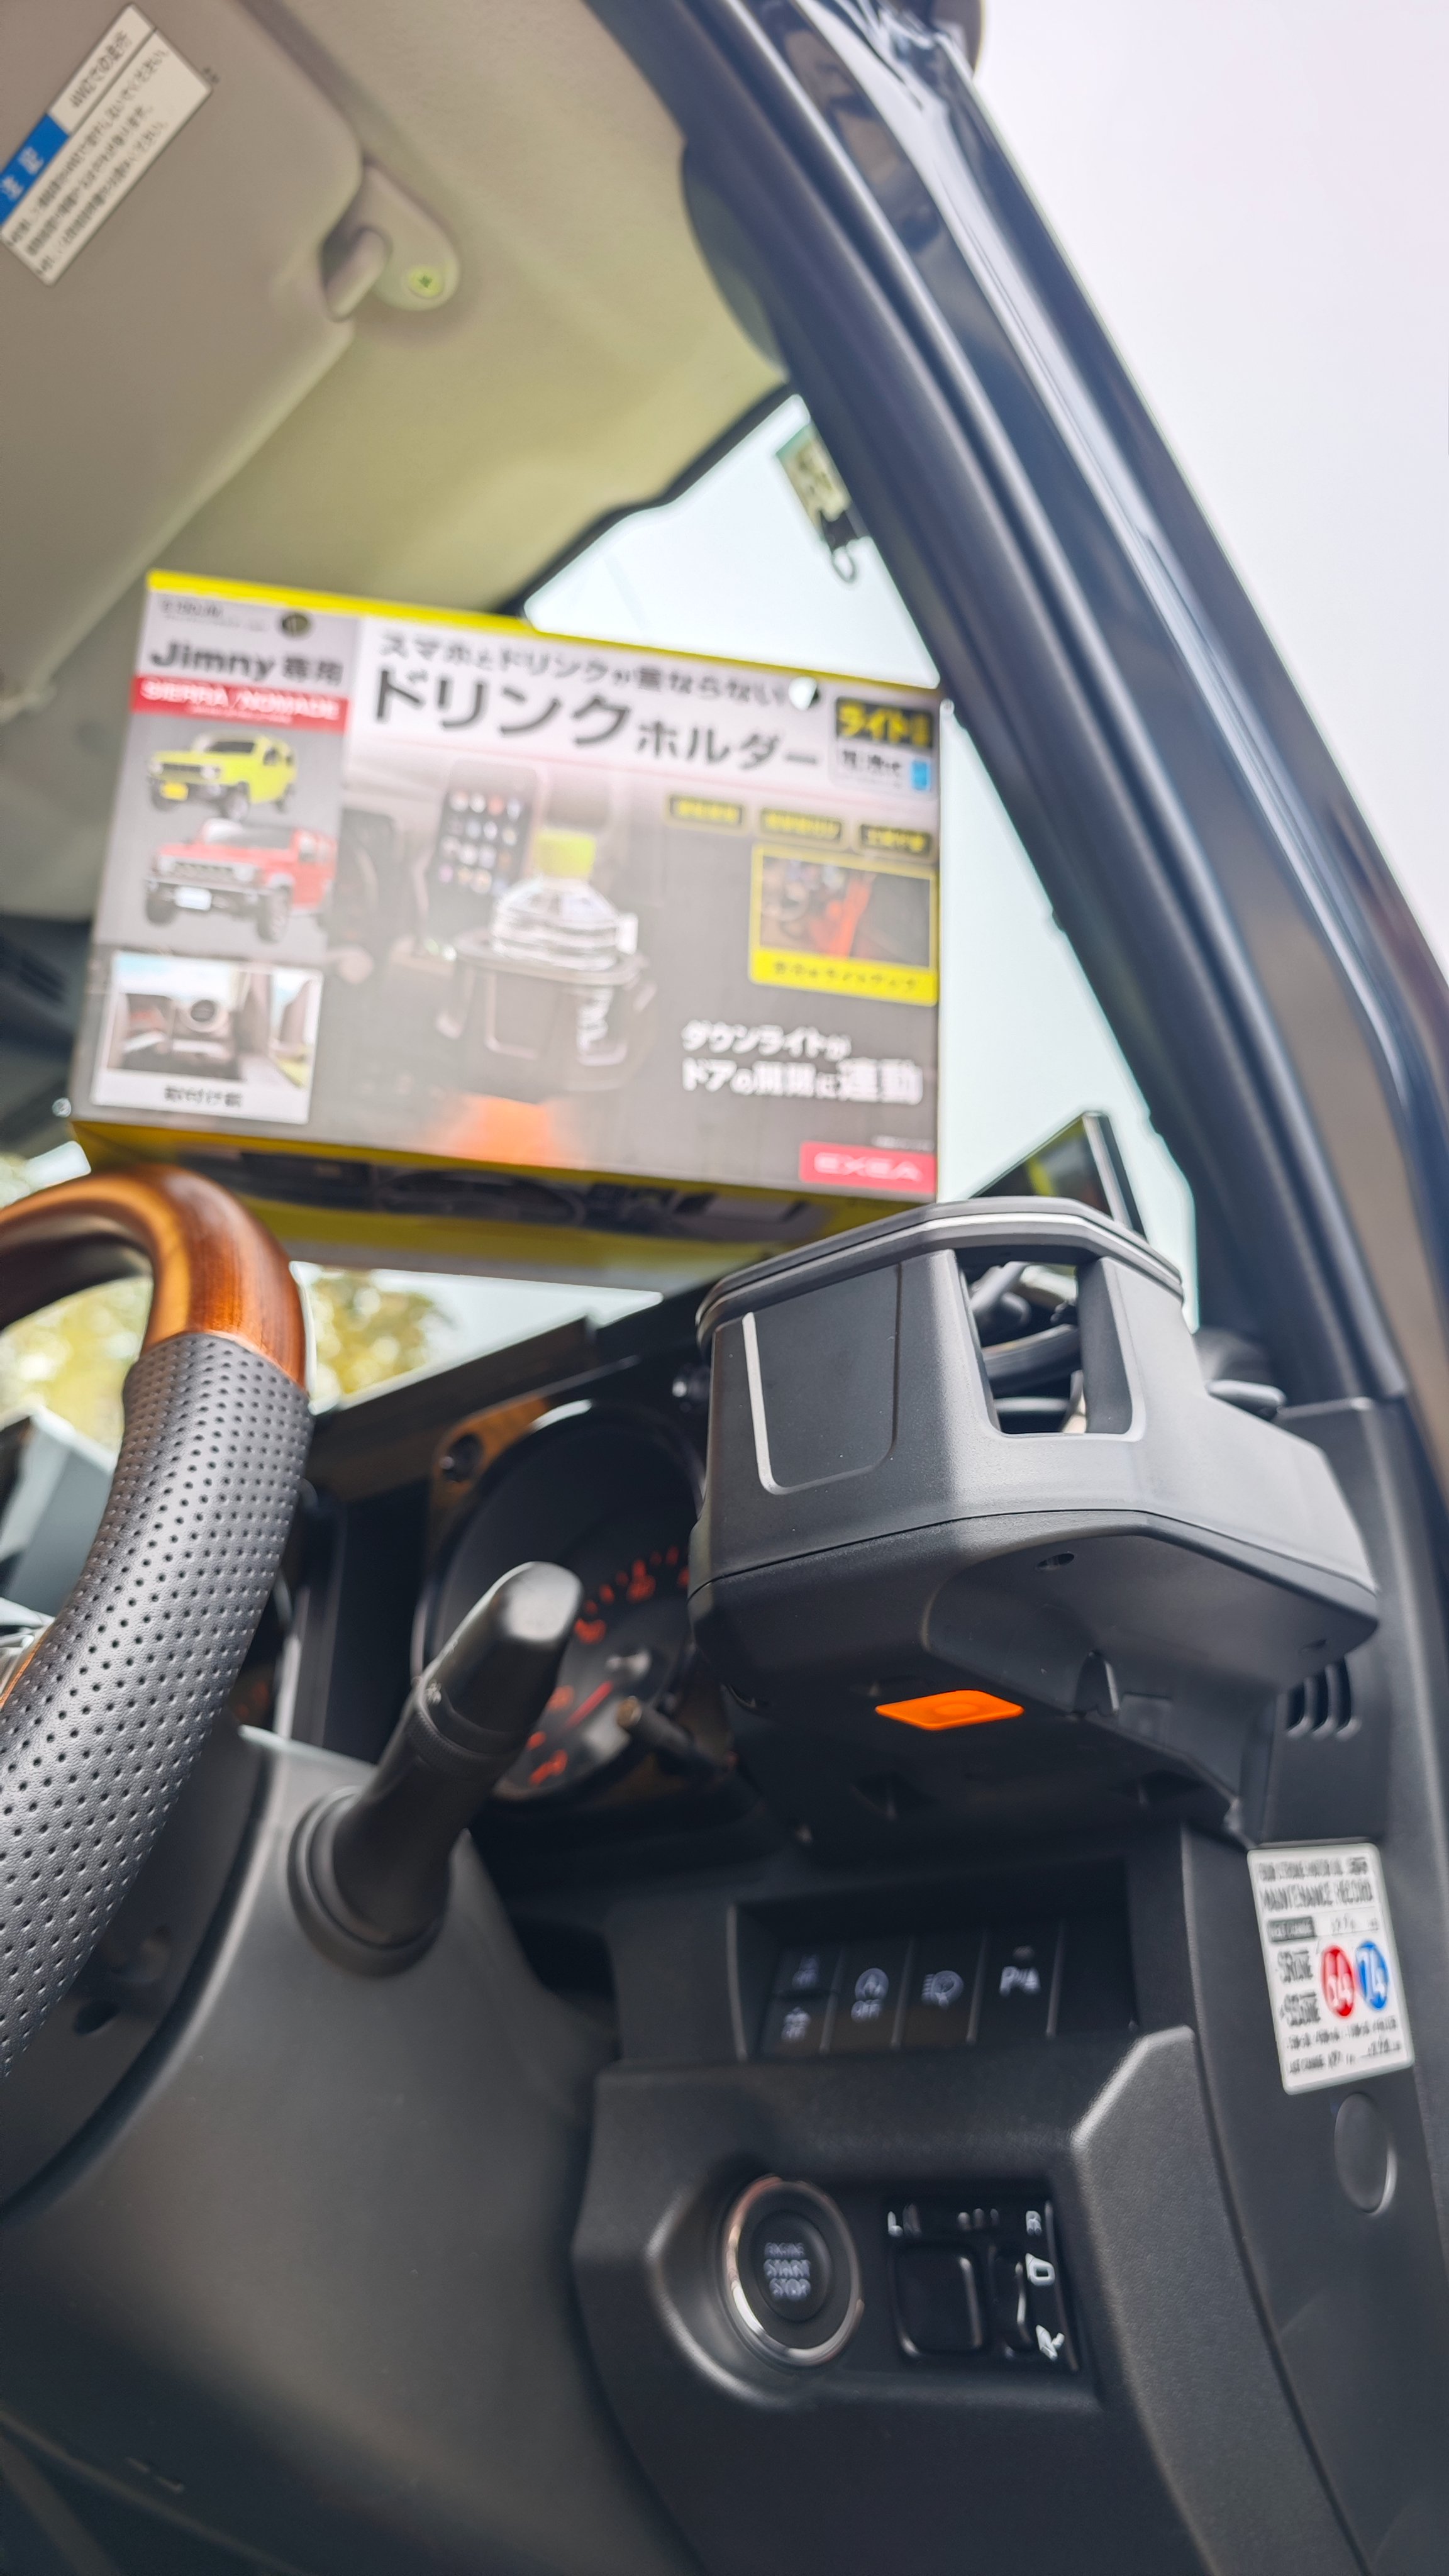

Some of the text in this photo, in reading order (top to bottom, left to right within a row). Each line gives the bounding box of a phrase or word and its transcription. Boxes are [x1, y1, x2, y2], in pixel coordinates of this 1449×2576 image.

[1263, 1879, 1374, 1911] MAINTENANCE RECORD
[764, 2259, 811, 2279] START
[769, 2278, 811, 2301] STOP
